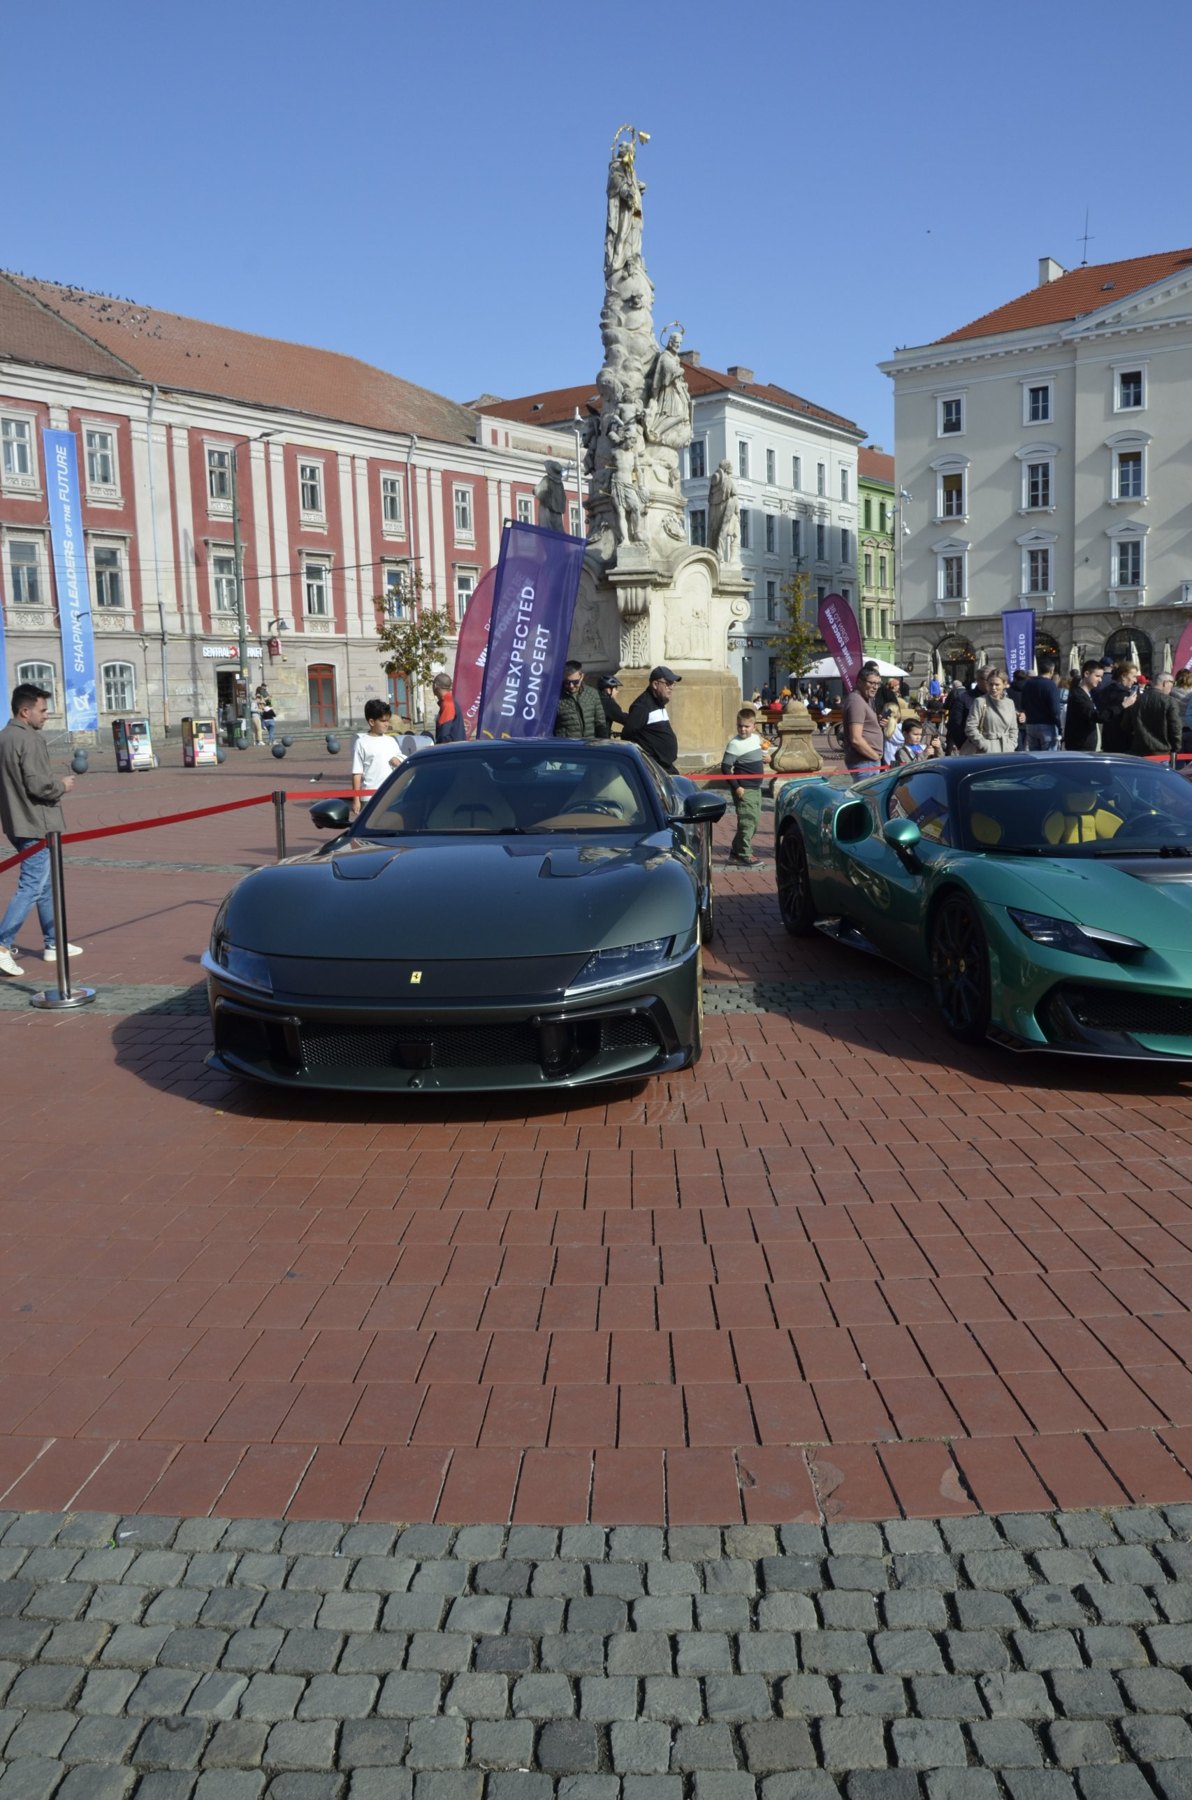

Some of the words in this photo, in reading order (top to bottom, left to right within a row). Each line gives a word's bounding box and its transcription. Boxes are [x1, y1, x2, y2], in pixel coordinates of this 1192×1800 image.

[56, 444, 70, 502] FUTURE
[64, 504, 72, 521] THE
[64, 540, 80, 607] LEADERS
[70, 610, 84, 673] SHAPING
[501, 586, 535, 717] UNEXPECTED
[522, 624, 550, 720] CONCERT
